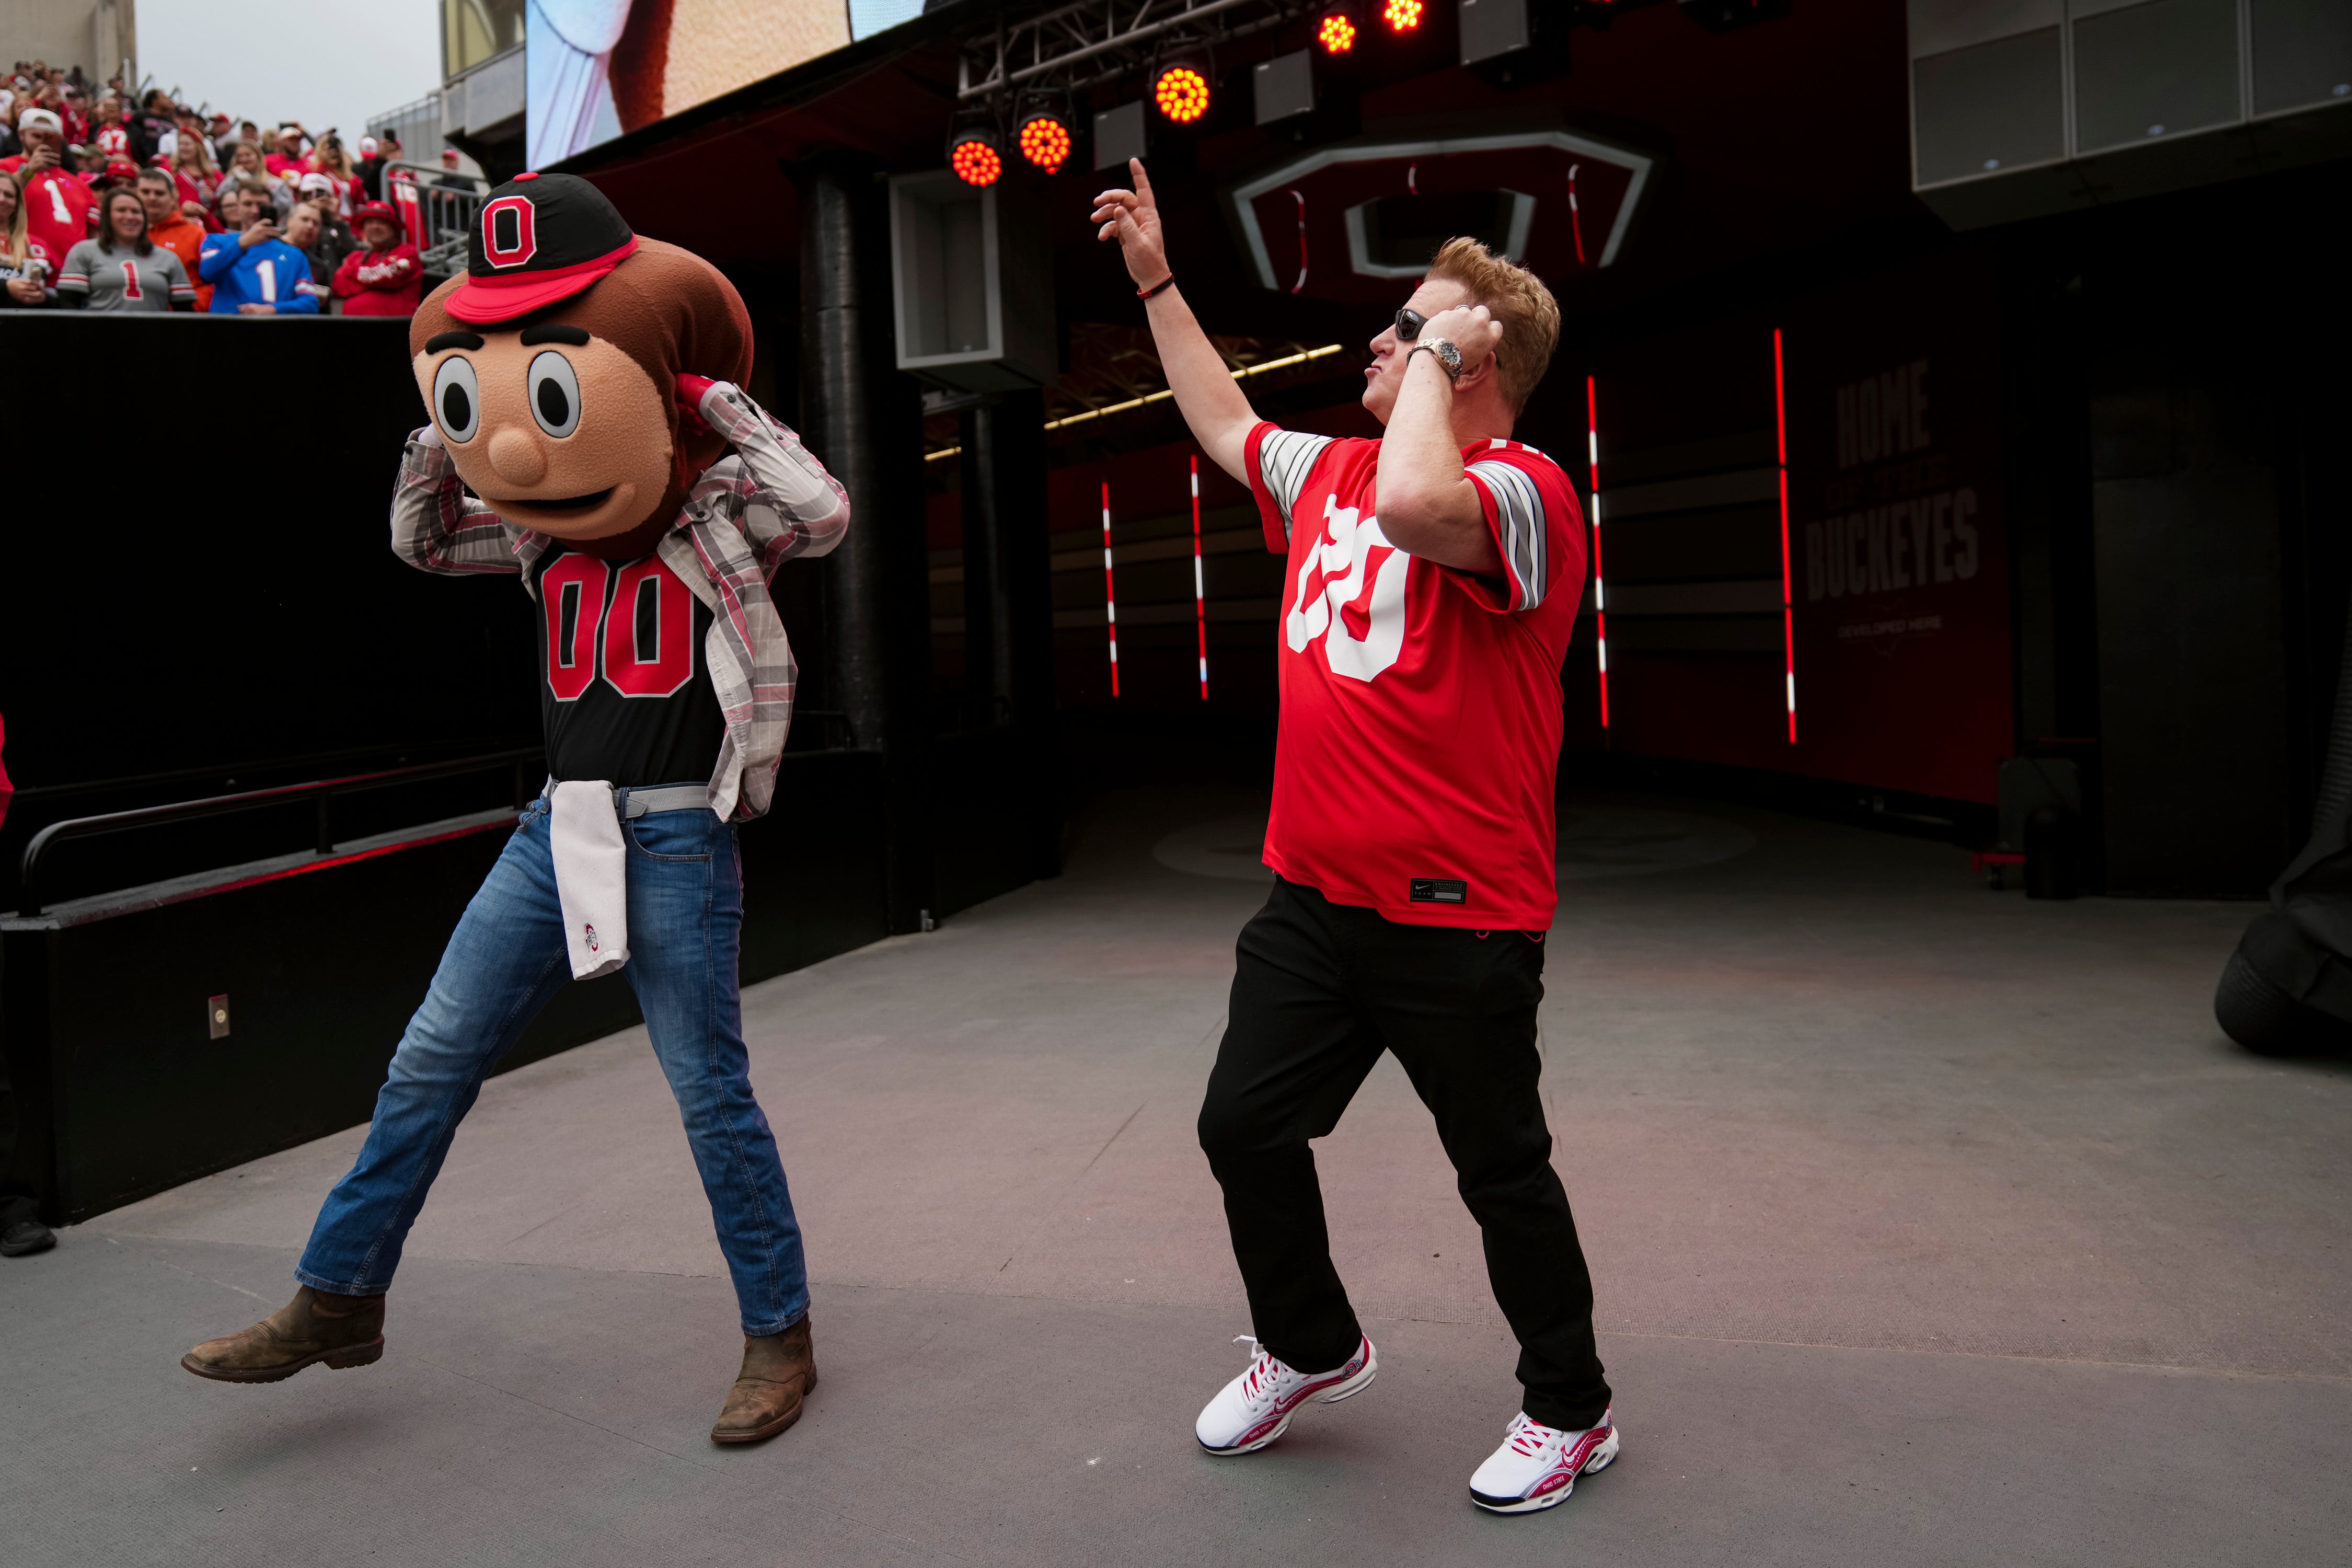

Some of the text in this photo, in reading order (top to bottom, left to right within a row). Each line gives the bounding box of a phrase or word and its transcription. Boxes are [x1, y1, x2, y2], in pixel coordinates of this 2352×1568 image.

[43, 179, 72, 224] 1
[481, 195, 537, 269] O
[119, 259, 144, 301] 1
[255, 258, 278, 303] 1
[1836, 357, 1931, 470] HOME
[1826, 453, 1949, 510] OF THE
[1805, 487, 1980, 602] BUCKEYES
[541, 551, 694, 701] 00
[1908, 614, 1943, 631] HERE
[1249, 1423, 1272, 1439] OHIO STATE
[1542, 1475, 1564, 1490] OHIO STATE
